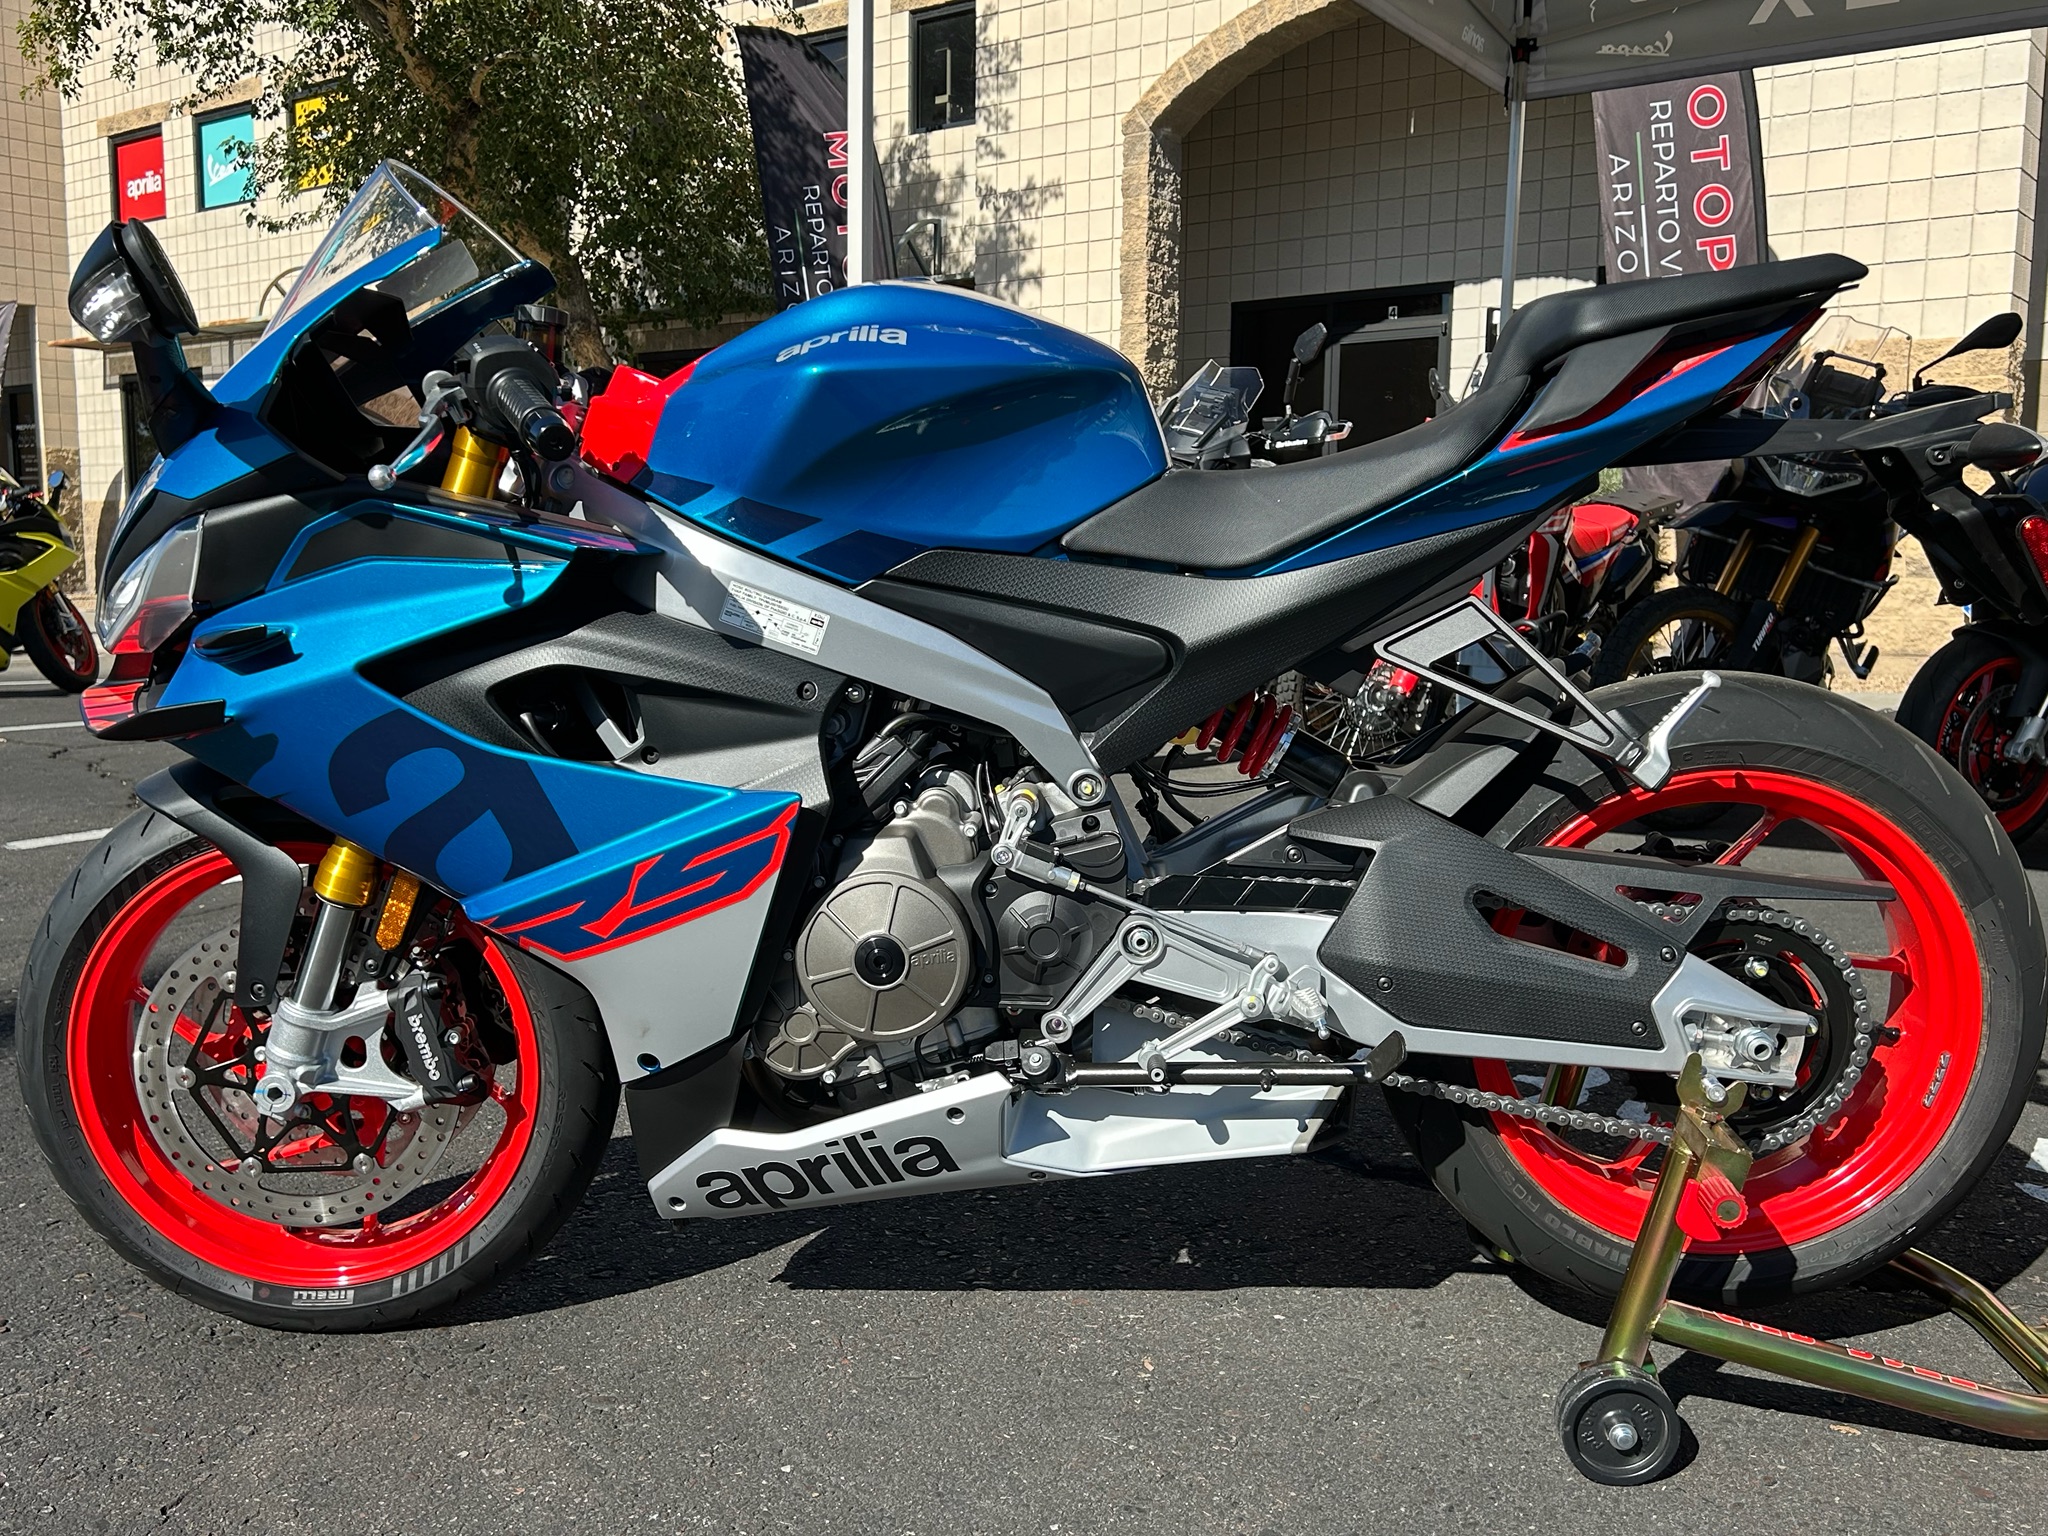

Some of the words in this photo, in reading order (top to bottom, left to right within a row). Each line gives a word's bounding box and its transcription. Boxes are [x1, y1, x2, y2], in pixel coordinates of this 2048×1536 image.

[127, 170, 162, 201] aprilia
[1649, 100, 1681, 244] REPARTO
[1608, 154, 1639, 274] ARIZO
[802, 184, 834, 297] REPARTO
[1660, 249, 1683, 278] V
[1389, 307, 1397, 319] 4
[775, 324, 908, 363] aprilia
[910, 948, 955, 969] aprilia
[407, 1013, 441, 1081] brembo
[696, 1130, 962, 1209] aprilia
[292, 1288, 355, 1306] PIRELLI
